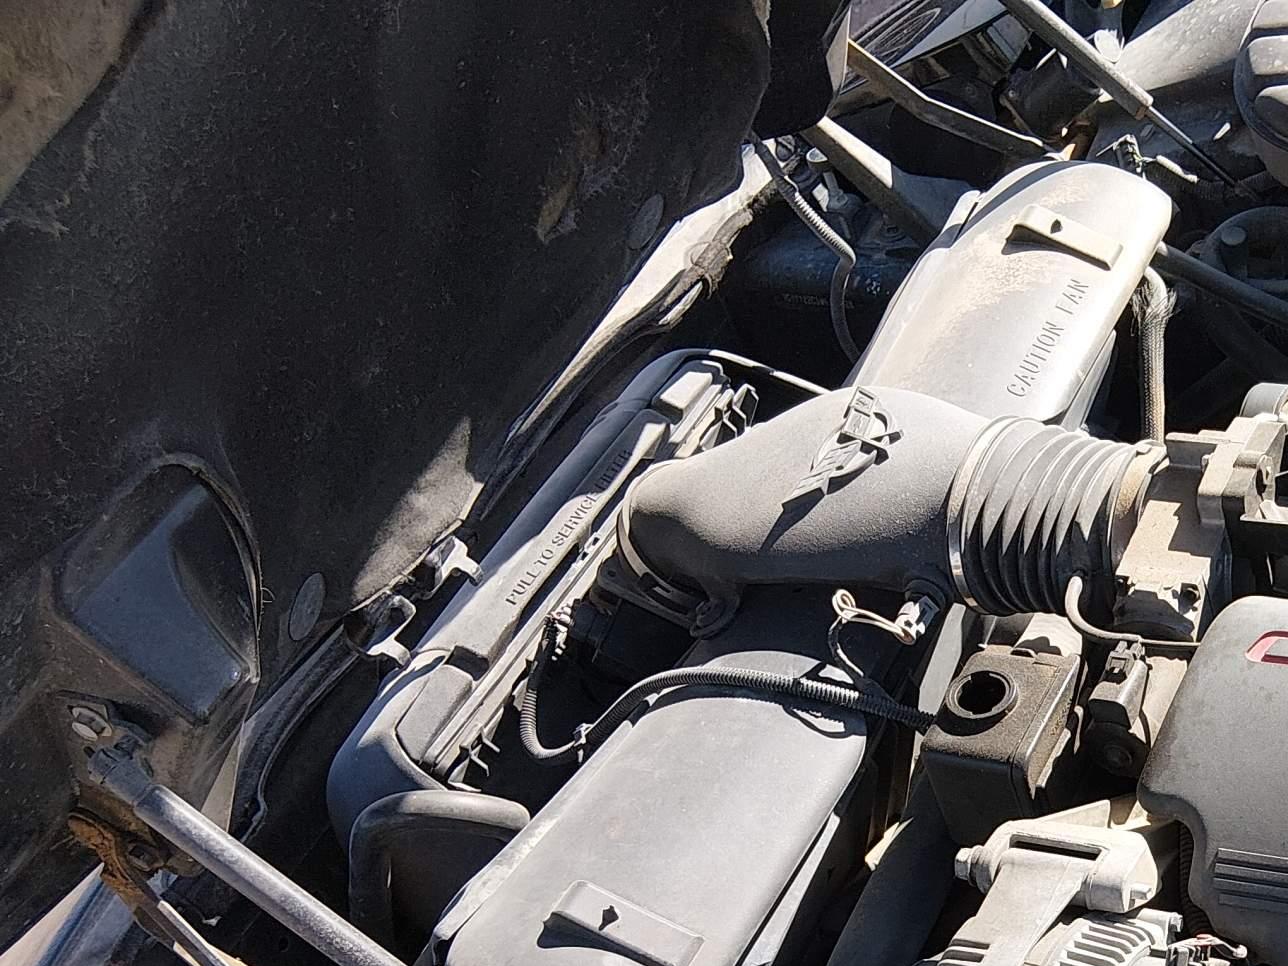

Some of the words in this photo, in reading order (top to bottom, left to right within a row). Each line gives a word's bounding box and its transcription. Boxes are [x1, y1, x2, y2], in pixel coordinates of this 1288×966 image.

[1006, 321, 1065, 397] CAUTION
[1055, 278, 1089, 315] FAN
[505, 570, 538, 606] PULL
[534, 548, 554, 567] TO
[552, 495, 597, 547] SERVICE
